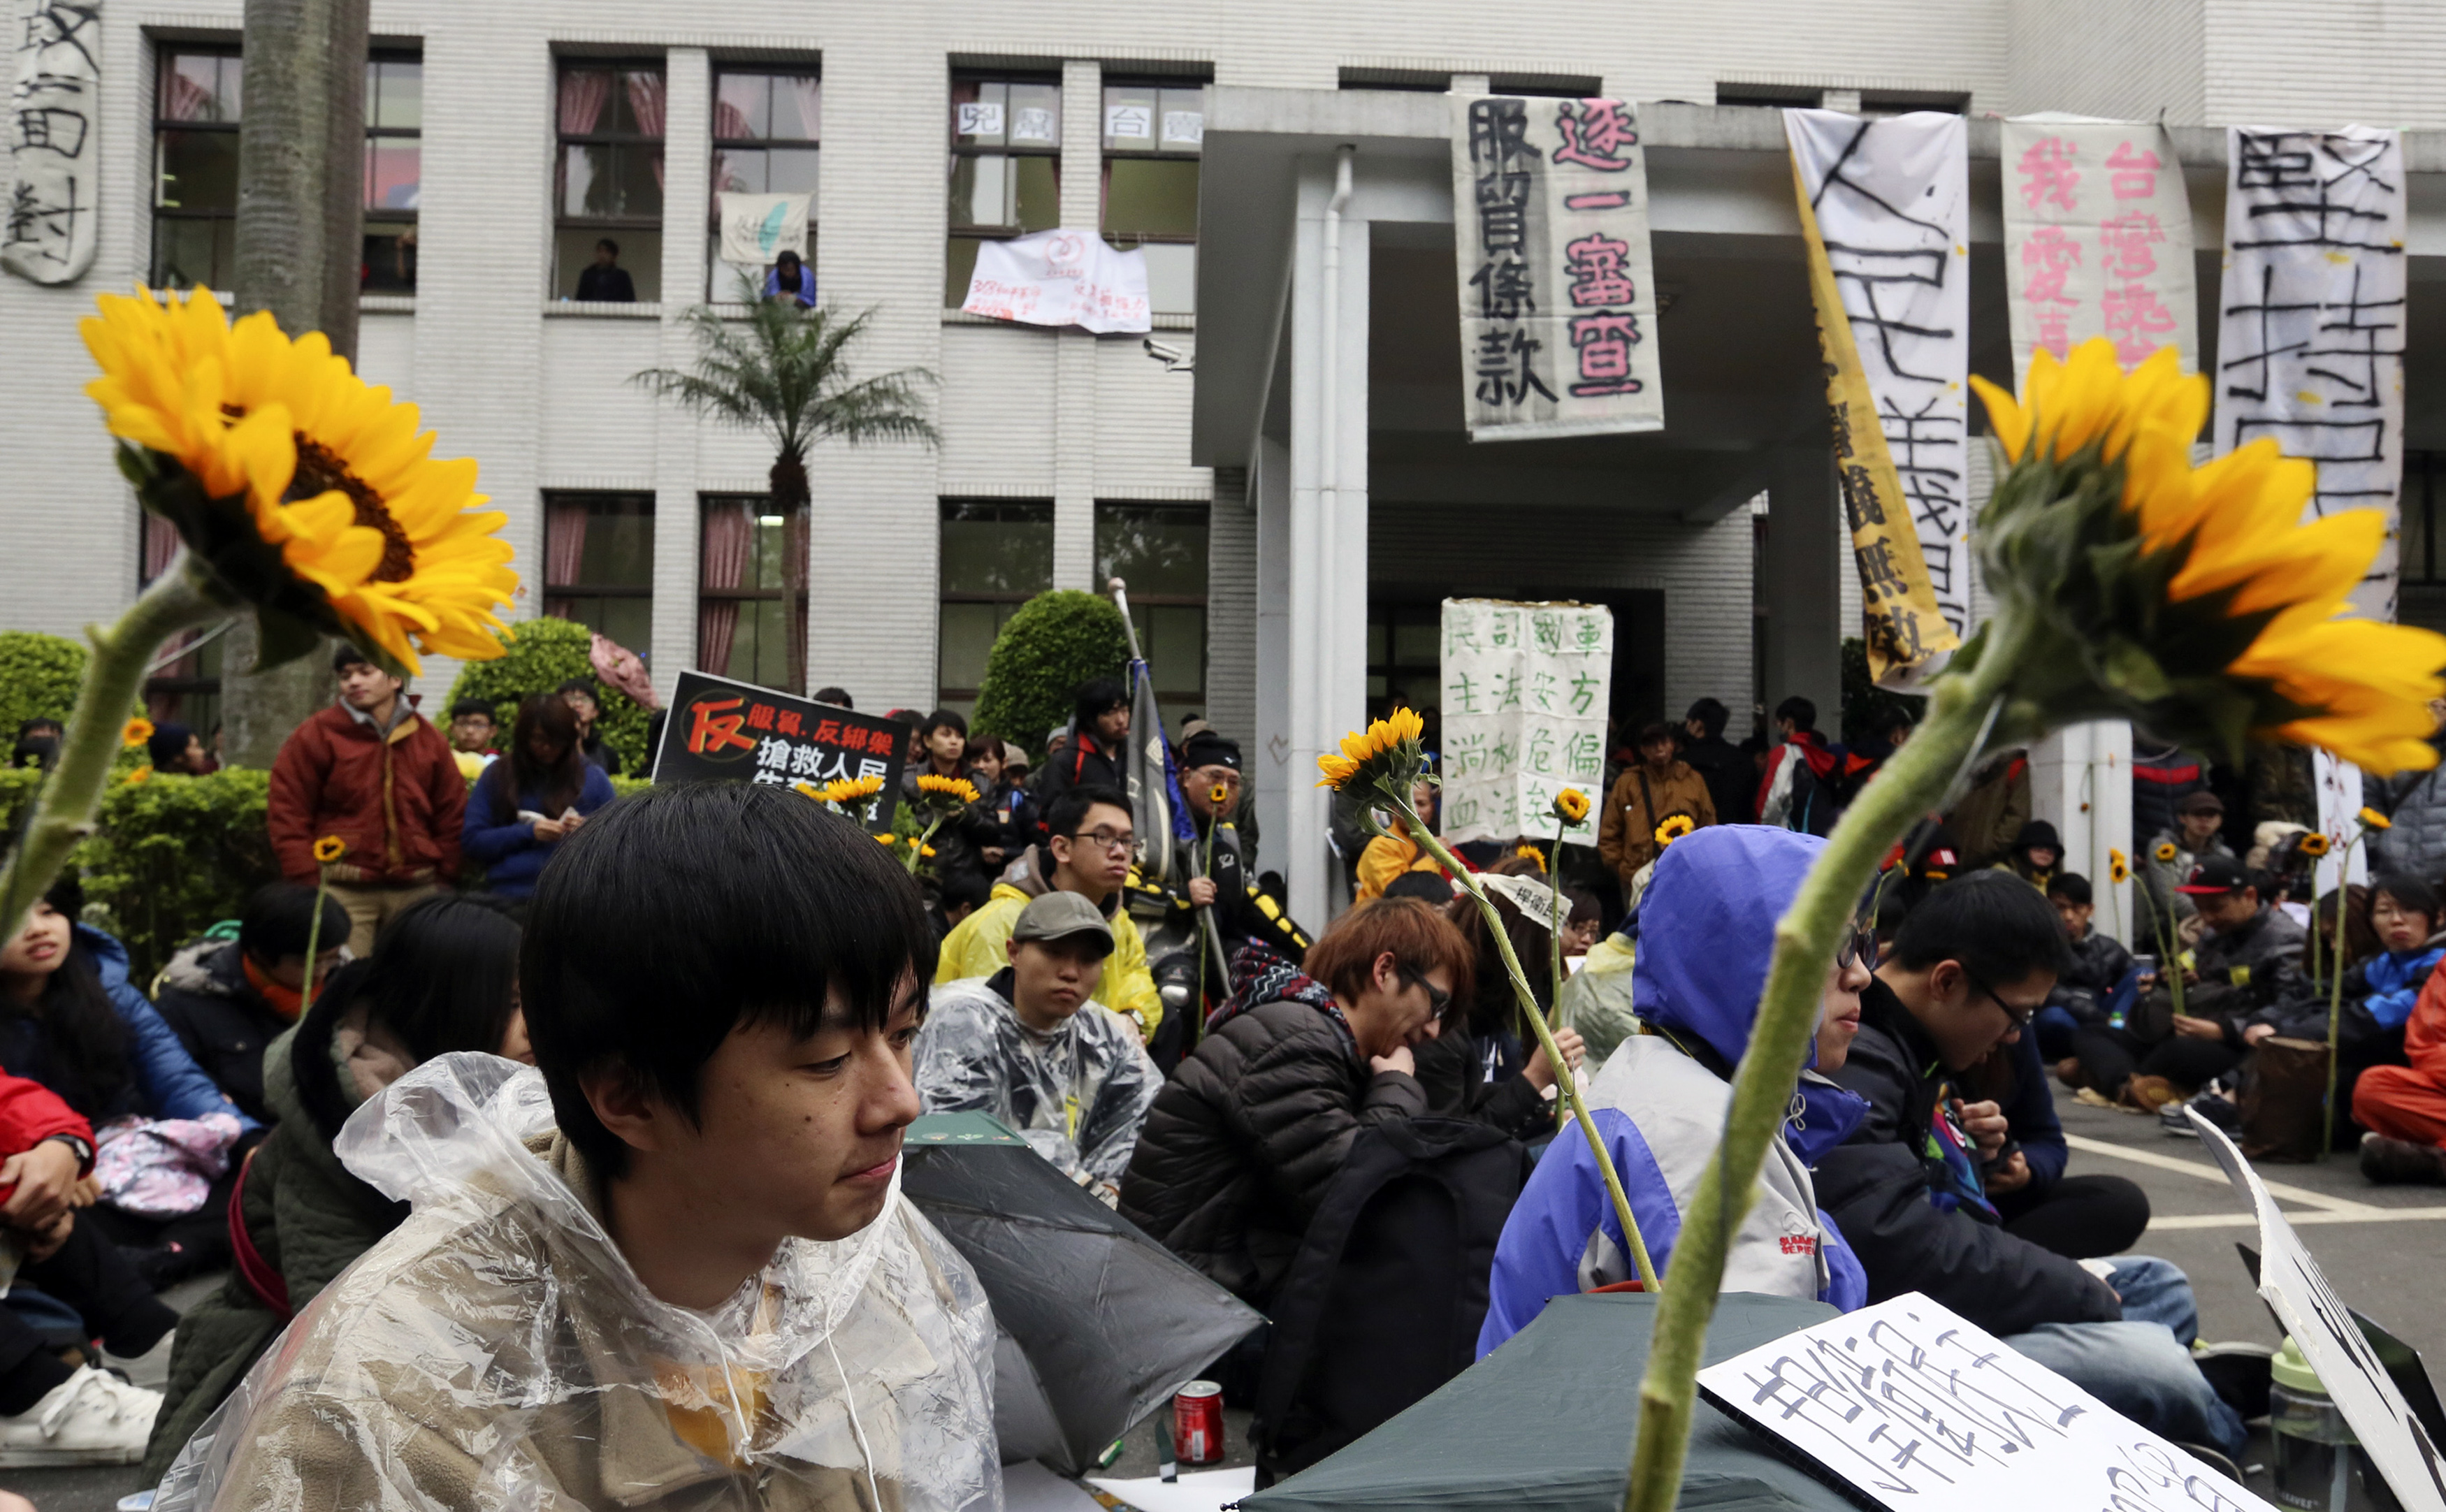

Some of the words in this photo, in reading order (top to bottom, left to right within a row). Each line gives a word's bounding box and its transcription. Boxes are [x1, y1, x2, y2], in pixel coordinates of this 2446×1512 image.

[688, 697, 758, 754] 反
[756, 735, 888, 792] 搶救人民
